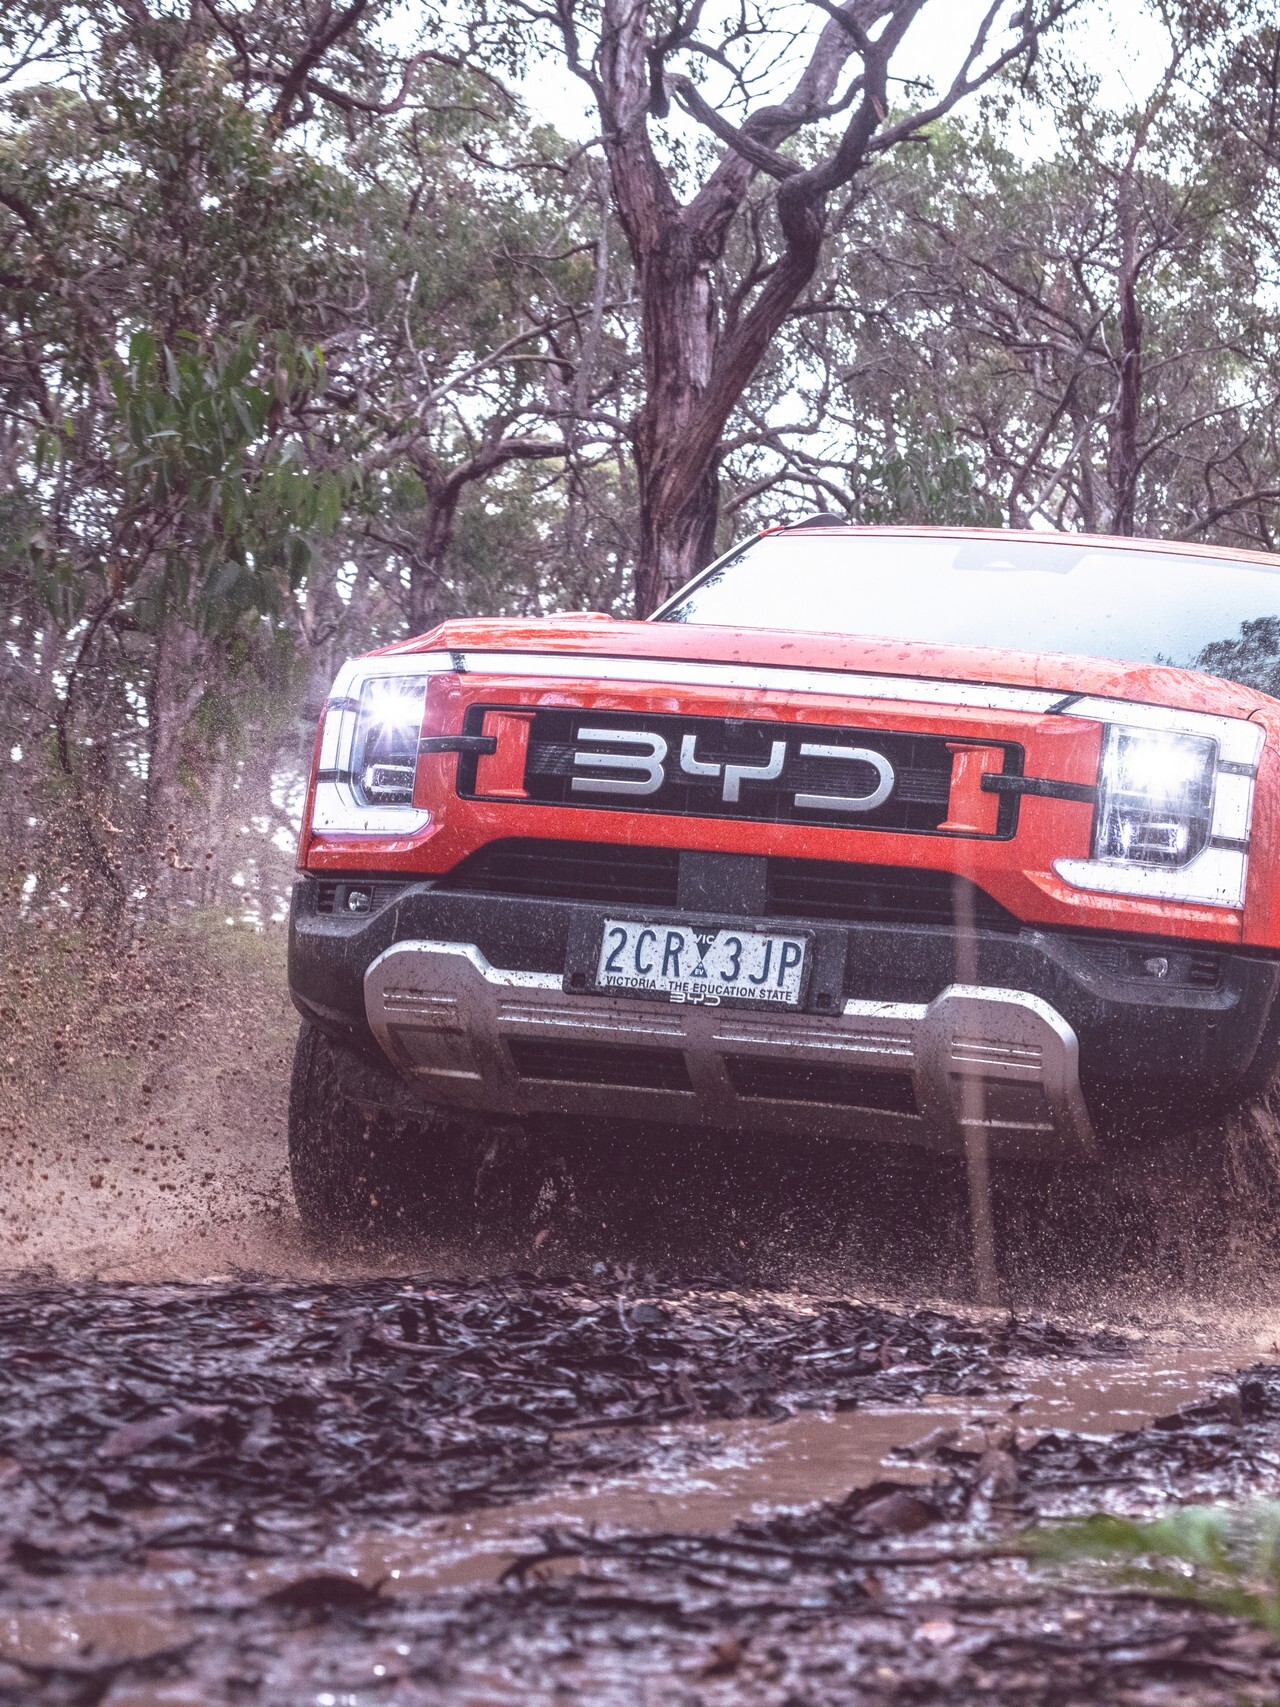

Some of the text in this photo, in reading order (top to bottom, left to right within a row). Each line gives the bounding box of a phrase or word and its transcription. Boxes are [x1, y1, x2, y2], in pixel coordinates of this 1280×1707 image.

[571, 727, 895, 812] BYD
[694, 934, 715, 945] VIC
[604, 926, 802, 988] 2CR 3JP
[694, 968, 704, 976] EV
[606, 975, 657, 989] VICTORIA
[668, 981, 690, 993] THE
[692, 982, 756, 998] EDUCATION
[759, 988, 793, 1001] STATE
[669, 991, 721, 1007] BYD
